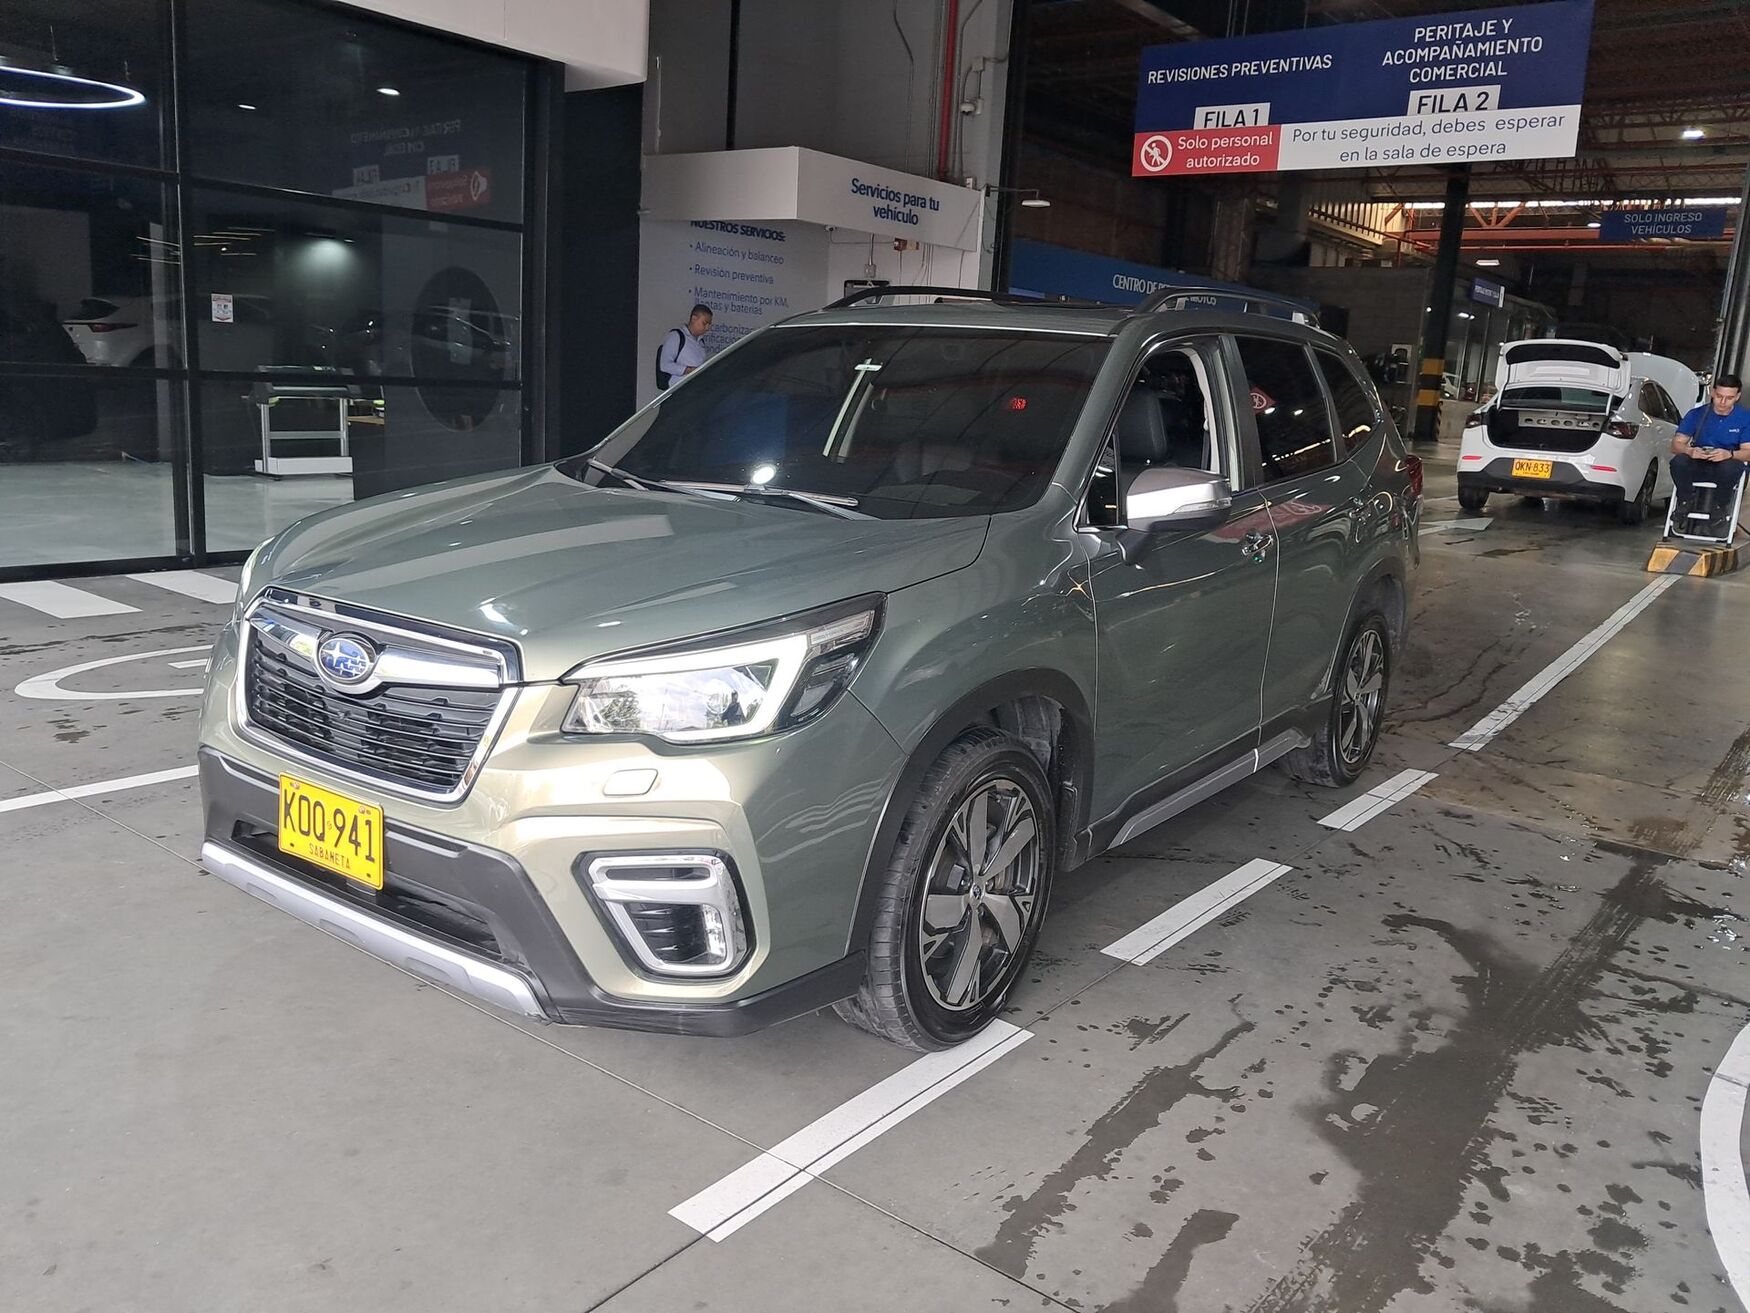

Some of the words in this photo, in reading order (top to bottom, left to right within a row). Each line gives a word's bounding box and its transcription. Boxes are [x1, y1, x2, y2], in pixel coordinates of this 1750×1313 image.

[1414, 19, 1498, 42] PERITAJE
[1503, 18, 1513, 34] Y
[1382, 36, 1543, 66] ACOMPAÑAMIENTO
[1147, 64, 1228, 84] REVISIONES
[1231, 54, 1333, 77] PREVENTIVAS
[1409, 61, 1508, 83] COMERCIAL
[1417, 93, 1469, 114] FILA
[1476, 91, 1490, 111] 2
[1203, 109, 1246, 128] FILA
[1252, 108, 1260, 126] 1
[1292, 128, 1318, 143] Por
[1321, 129, 1336, 141] tu
[1341, 120, 1427, 141] seguridad,
[1432, 118, 1486, 134] debes
[1495, 113, 1566, 134] esperar
[1178, 136, 1208, 150] Solo
[1211, 131, 1273, 151] personal
[1186, 152, 1260, 168] autorizado
[1340, 150, 1360, 162] en
[1365, 147, 1381, 161] la
[1382, 145, 1414, 160] sala
[1420, 142, 1442, 158] de
[1446, 142, 1507, 159] espera
[851, 178, 902, 203] Servicios
[903, 193, 927, 208] para
[929, 196, 940, 211] tu
[1624, 213, 1652, 223] SOLO
[1654, 212, 1703, 223] INGRESO
[748, 248, 785, 265] balanceo
[732, 271, 774, 285] preventiva
[1112, 274, 1146, 293] CENTRO
[694, 286, 758, 304] Mantenimiento
[333, 808, 375, 863] 941
[309, 842, 352, 870] SABANETA
